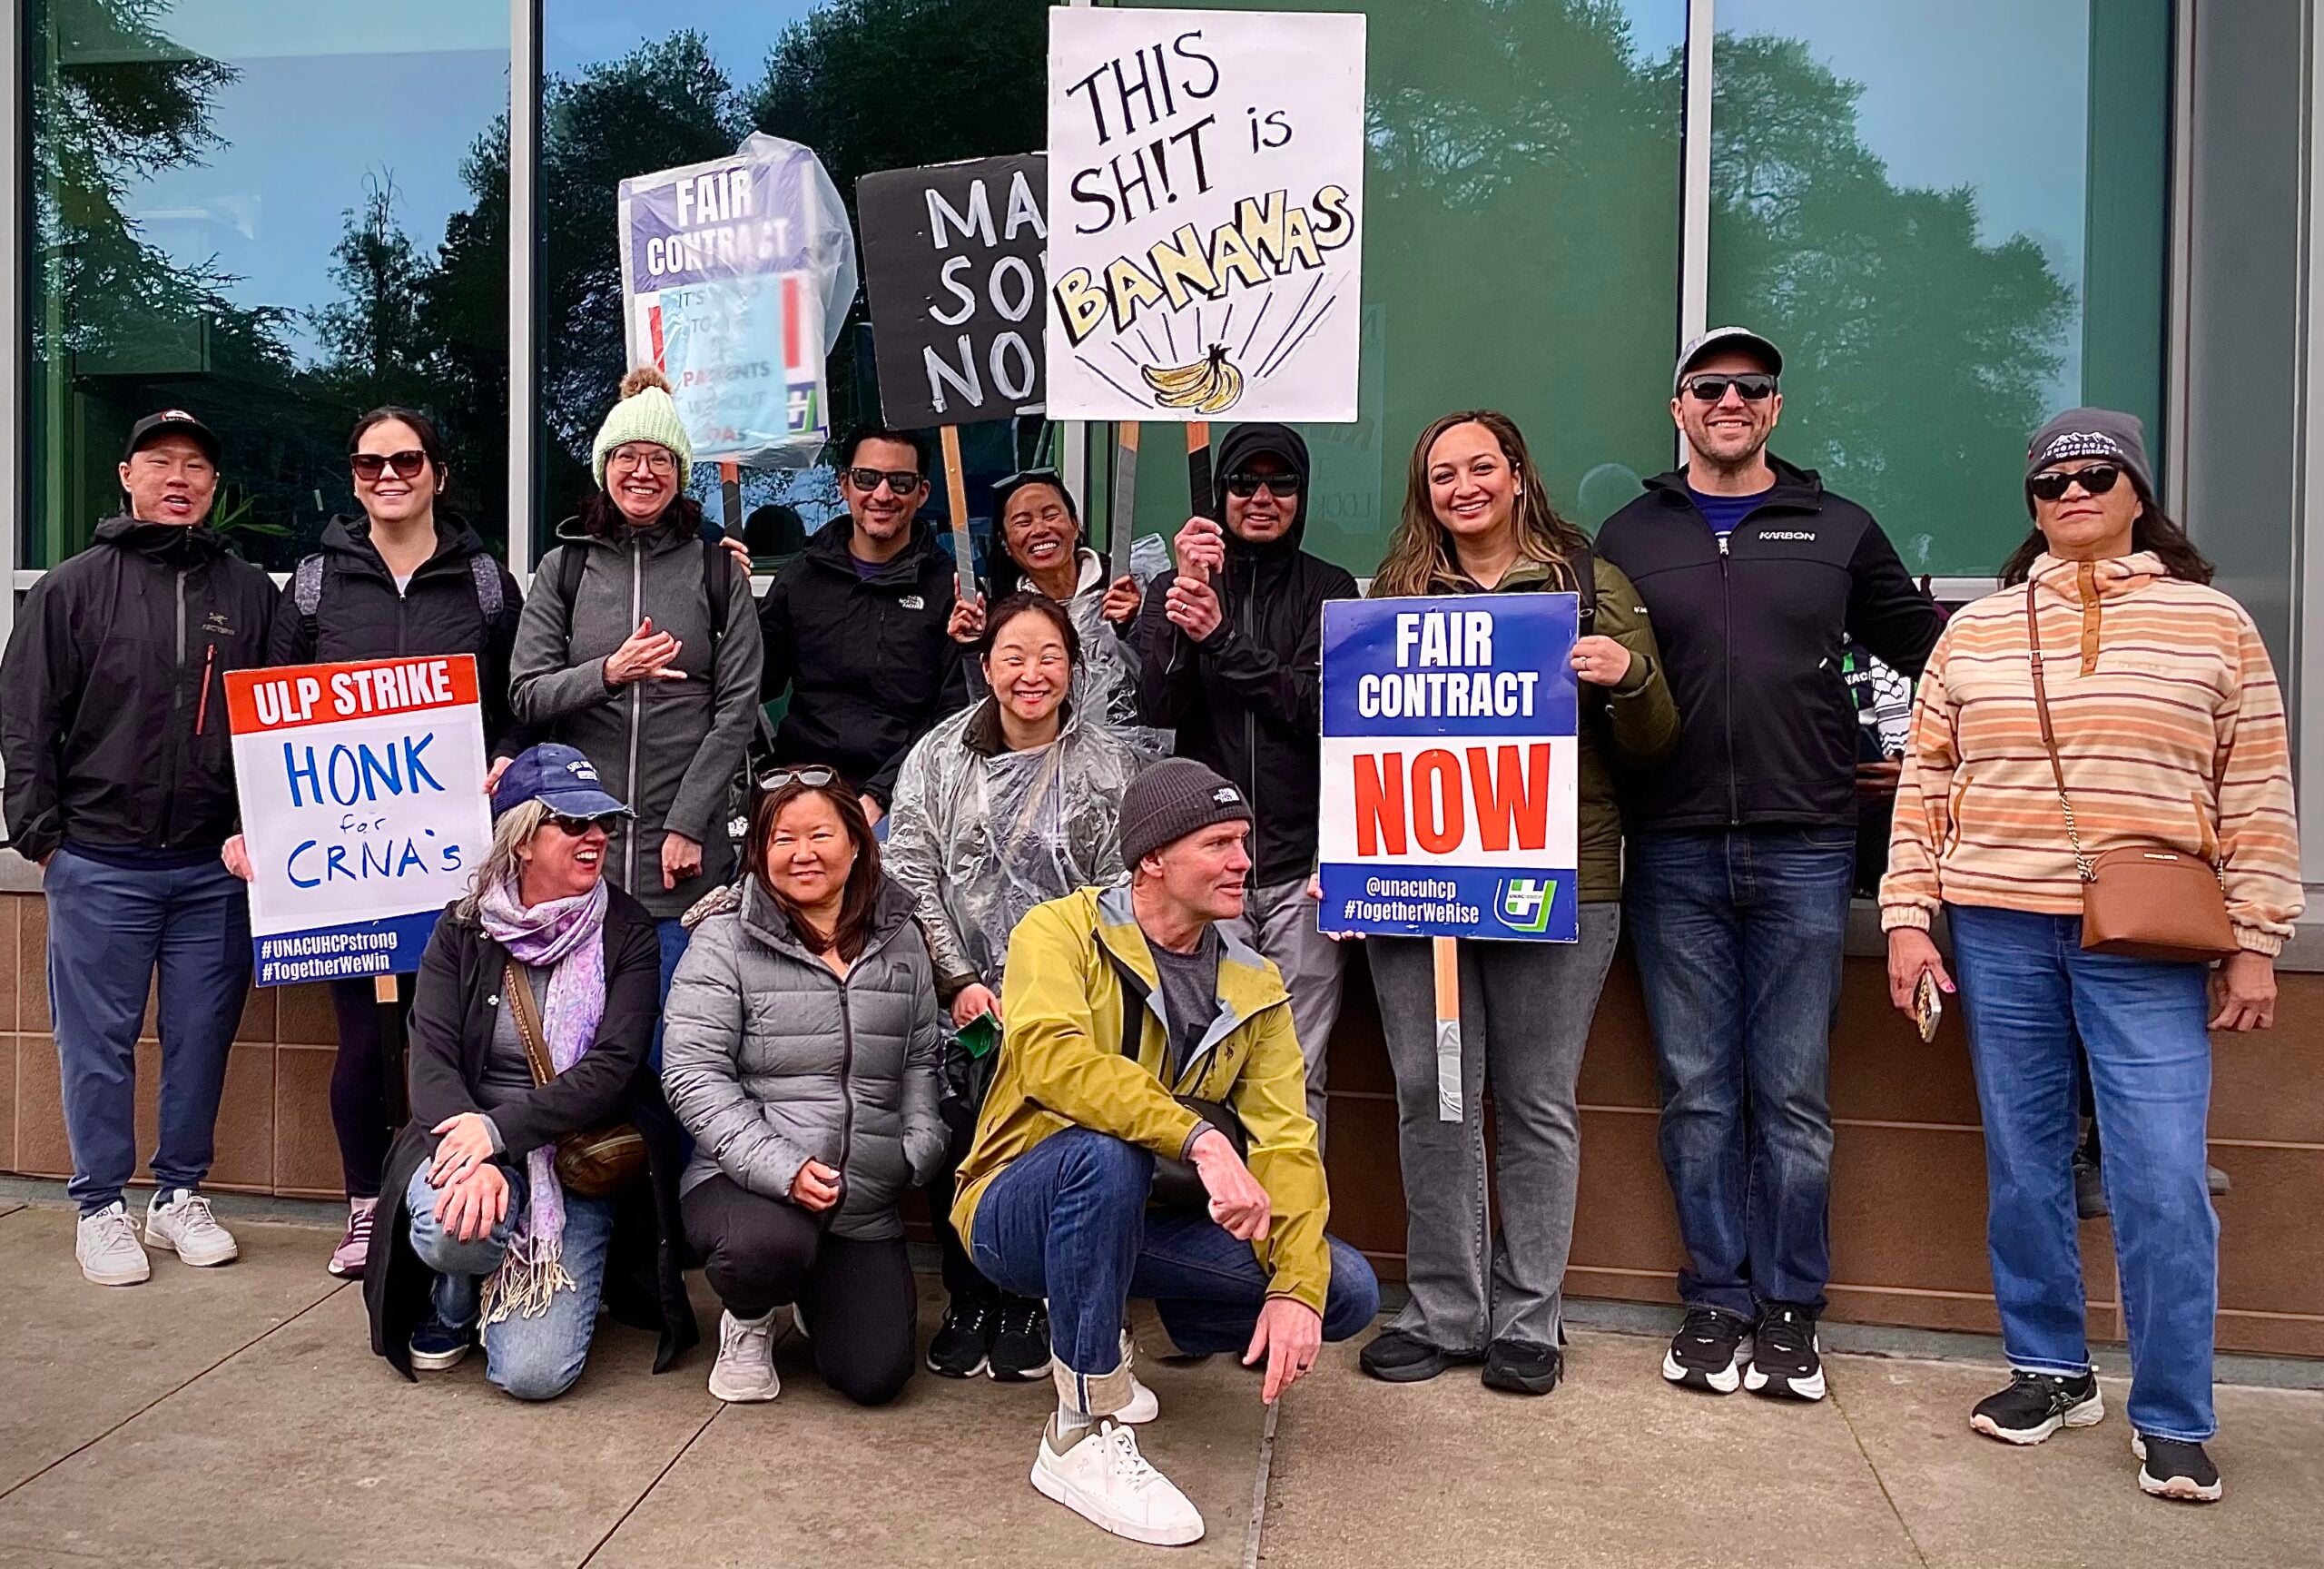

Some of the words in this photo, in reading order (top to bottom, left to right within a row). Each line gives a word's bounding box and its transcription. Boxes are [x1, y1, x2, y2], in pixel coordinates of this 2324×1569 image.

[1066, 30, 1219, 145] THIS
[675, 169, 753, 227] FAIR
[1070, 114, 1216, 235] SH!T
[1246, 107, 1292, 153] is
[928, 251, 1048, 326] SO
[1052, 184, 1354, 349] BANANAS
[923, 328, 1048, 413] NO
[1758, 531, 1816, 541] KARBON
[1395, 610, 1494, 668] FAIR
[252, 679, 321, 726] ULP
[330, 659, 454, 716] STRIKE
[1357, 672, 1539, 719] CONTRACT
[283, 732, 446, 807] HONK
[340, 814, 388, 834] for
[1353, 742, 1551, 856] NOW
[1344, 900, 1480, 924] #TogetherWeRise
[1366, 876, 1456, 902] @unacuhcp
[261, 931, 399, 959] #UNACUHCPstrong
[261, 952, 390, 982] #TogetherWeWin
